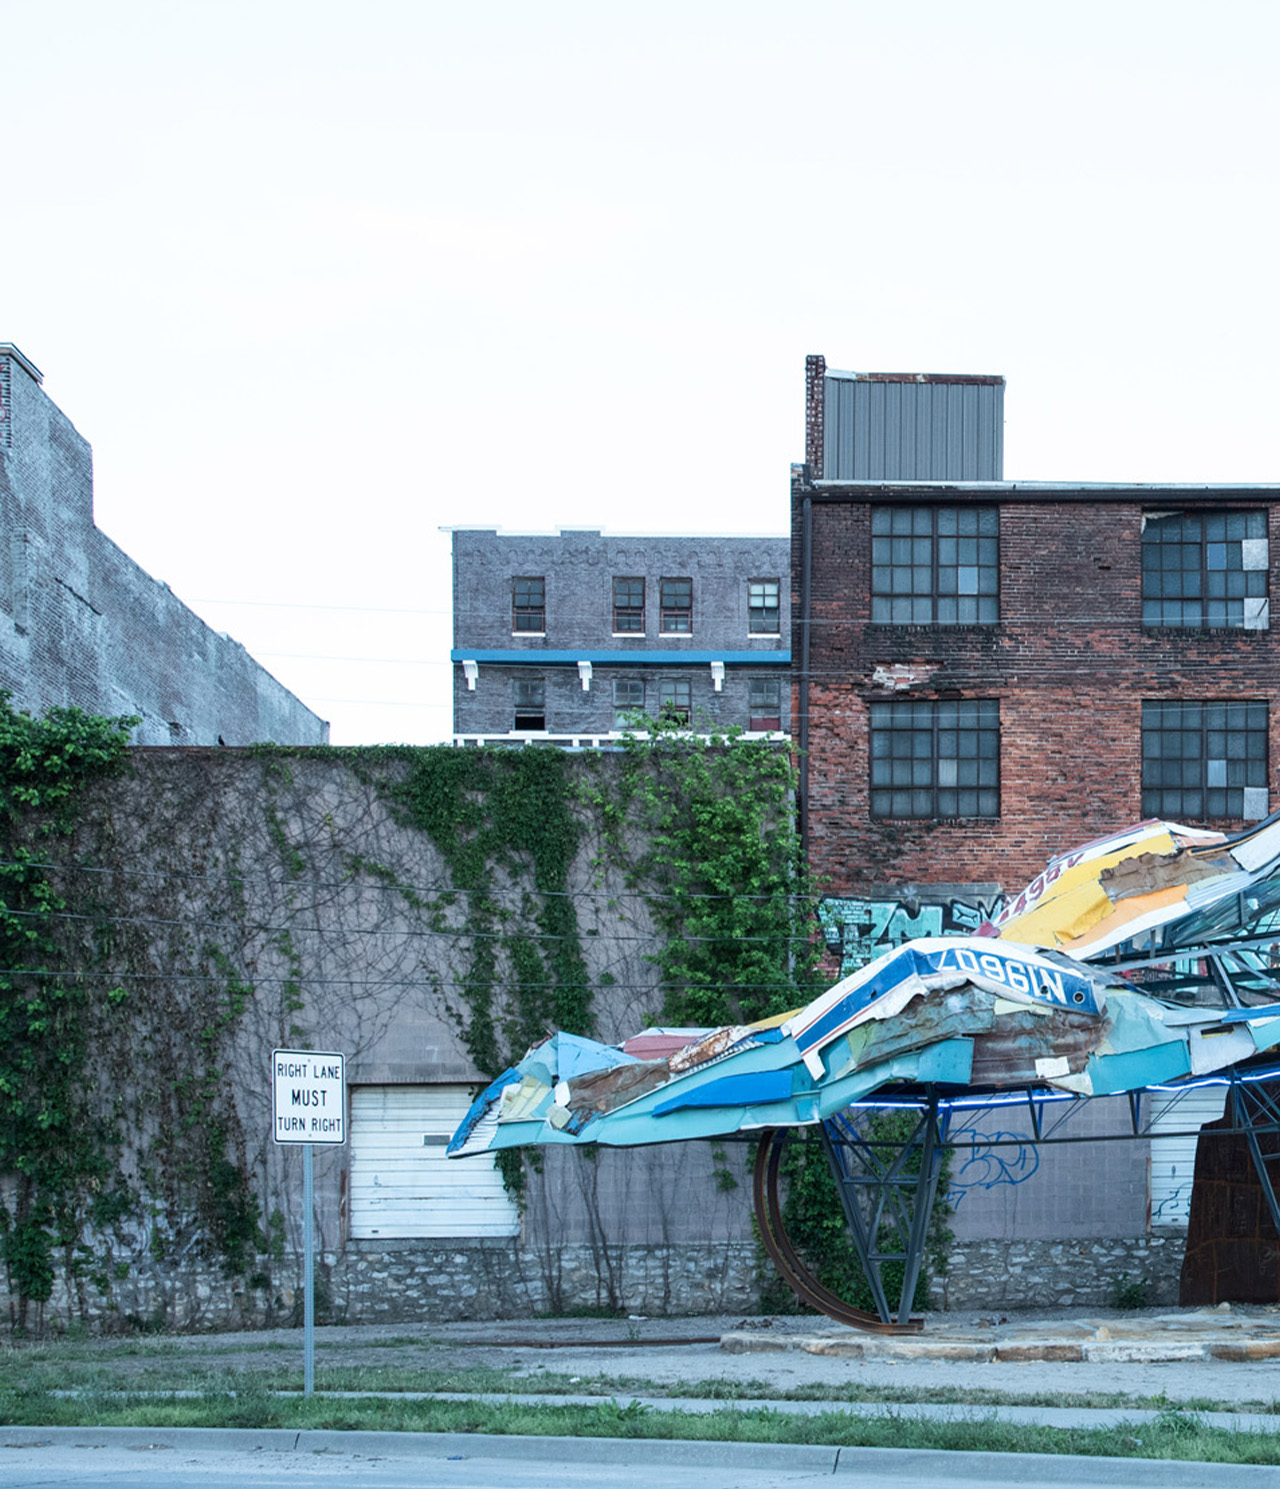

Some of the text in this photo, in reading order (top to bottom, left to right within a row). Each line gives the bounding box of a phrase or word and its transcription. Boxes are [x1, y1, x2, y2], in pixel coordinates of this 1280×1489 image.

[936, 949, 1068, 1005] N19607
[277, 1063, 340, 1080] RIGHT LANE
[291, 1089, 327, 1106] MUST
[278, 1117, 341, 1132] TURN RIGHT
